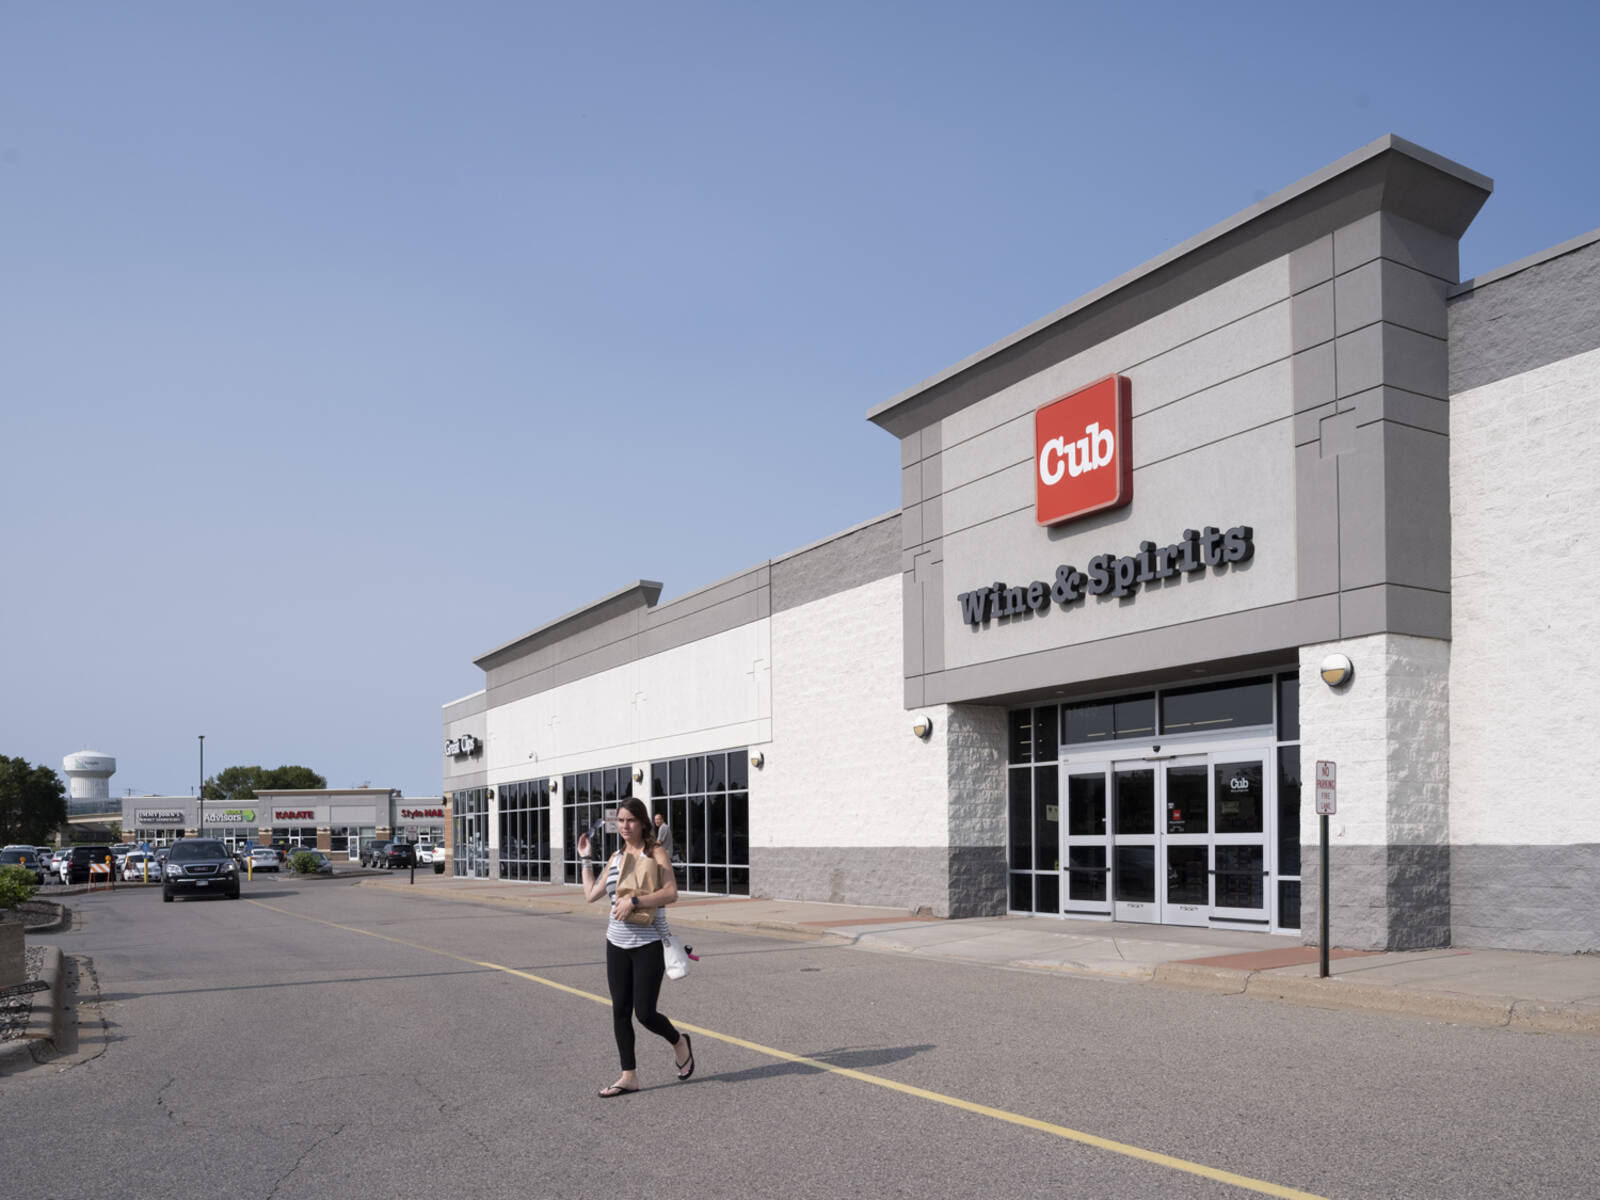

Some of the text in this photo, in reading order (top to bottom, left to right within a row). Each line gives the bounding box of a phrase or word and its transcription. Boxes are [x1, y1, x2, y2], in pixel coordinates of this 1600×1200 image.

[1039, 422, 1115, 486] Cub
[957, 525, 1255, 626] Wine & Spirits
[1321, 766, 1330, 777] NO
[1230, 777, 1249, 790] Cub
[205, 813, 243, 822] Advisors
[275, 810, 314, 819] KARATE
